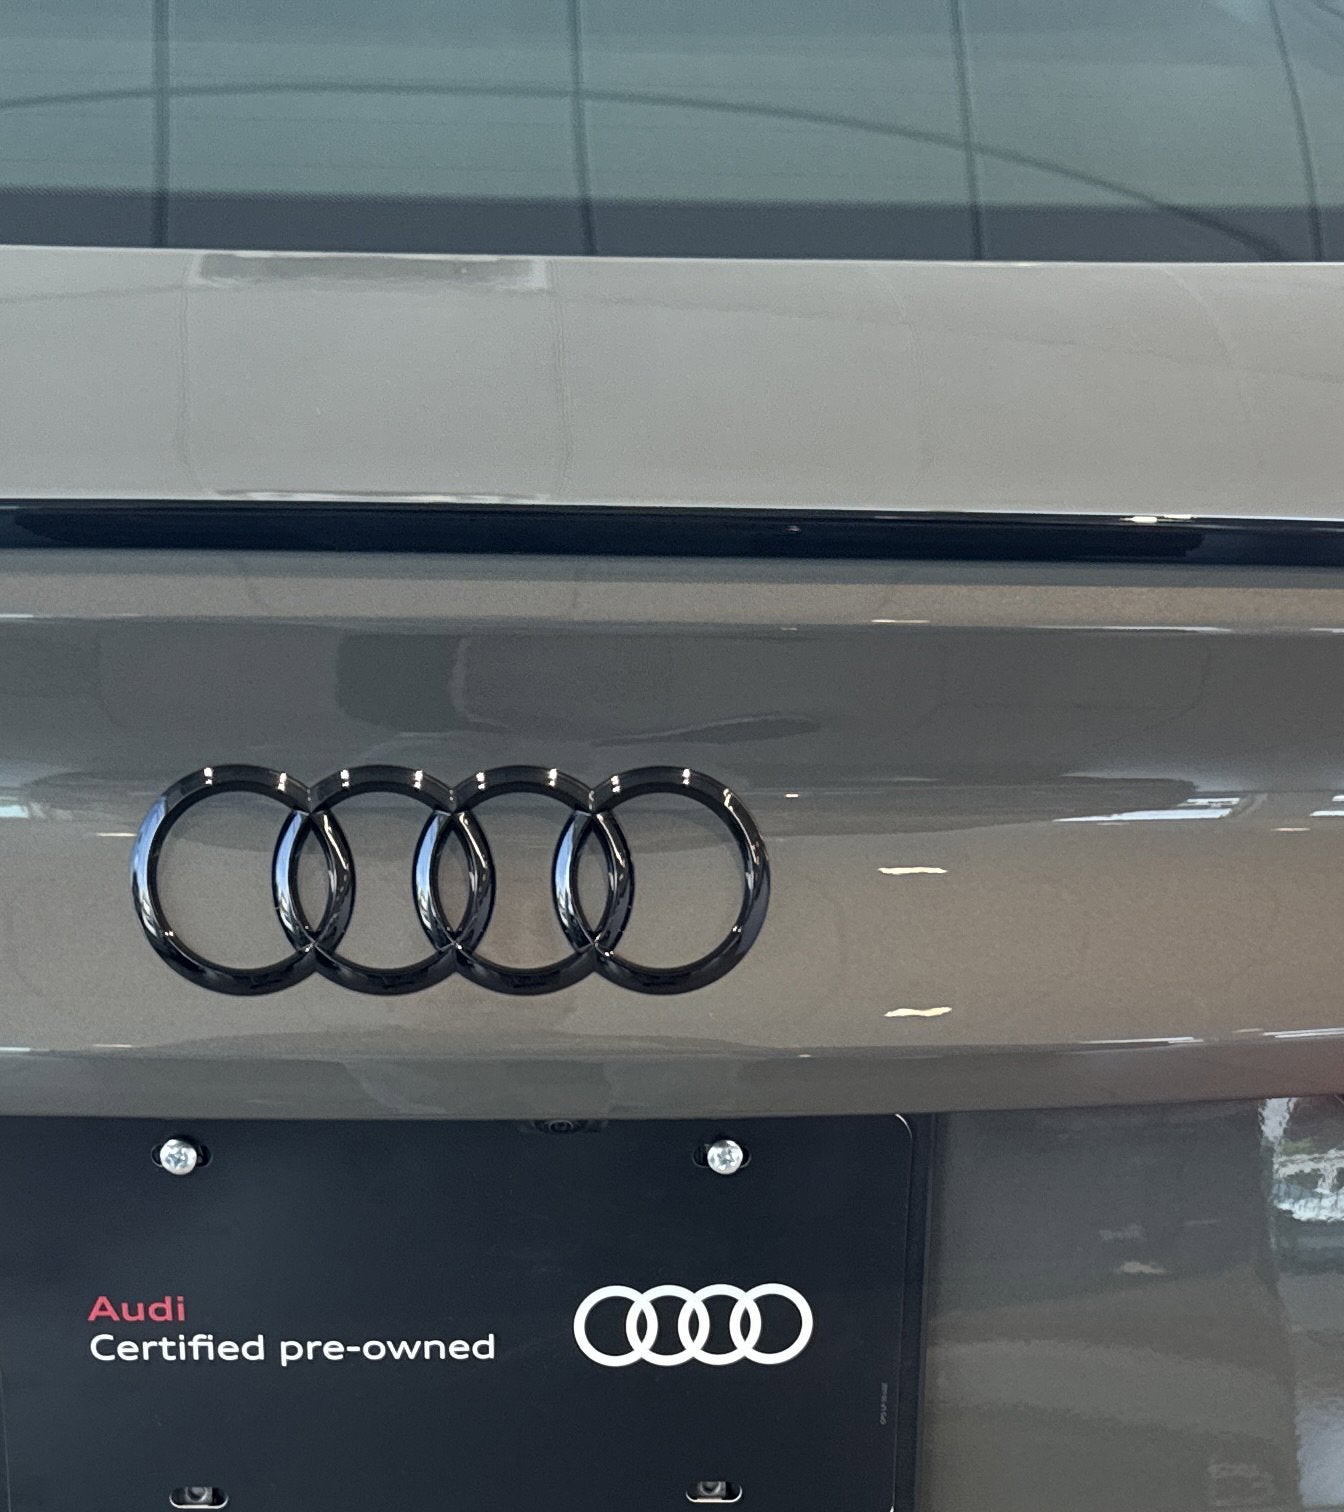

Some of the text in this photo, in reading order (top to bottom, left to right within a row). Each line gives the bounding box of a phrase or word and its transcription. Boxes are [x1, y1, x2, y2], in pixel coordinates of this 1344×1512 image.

[87, 1295, 186, 1322] Audi
[90, 1333, 495, 1367] Certified pre-owned
